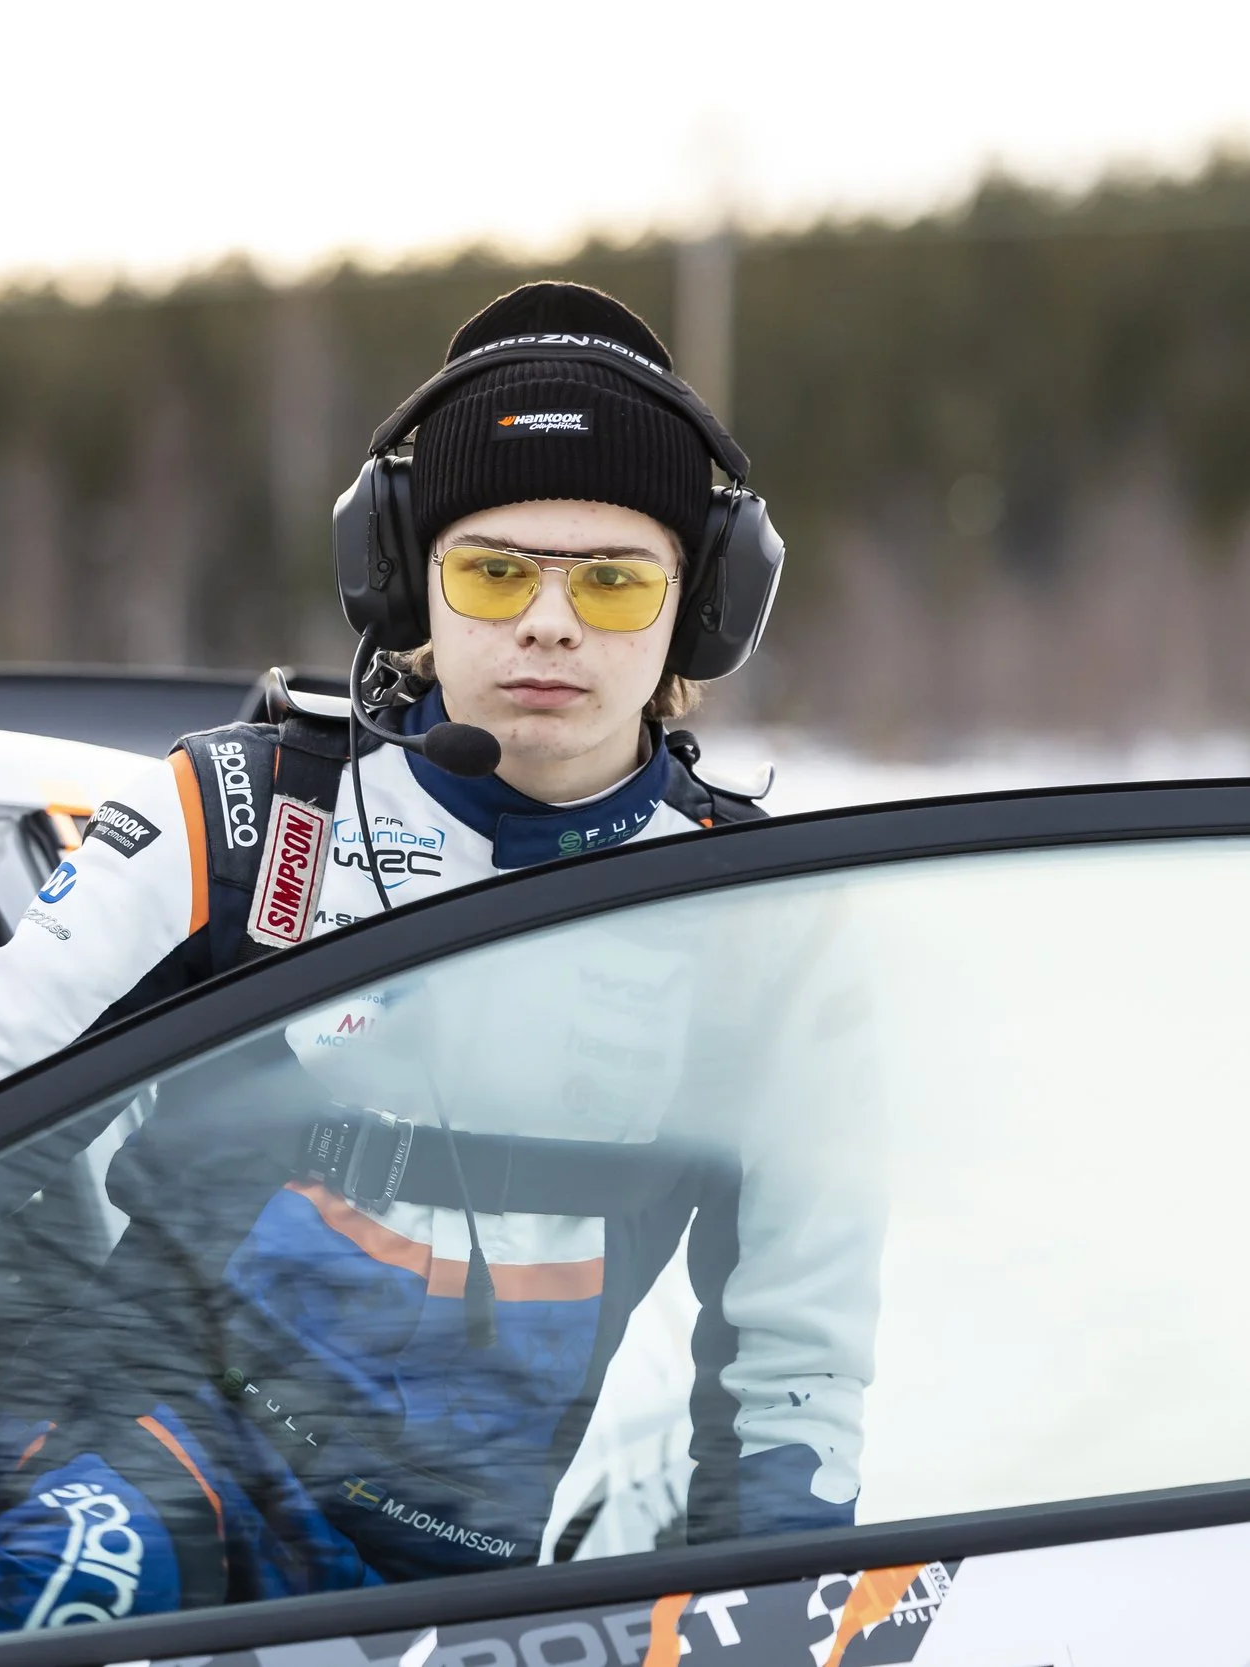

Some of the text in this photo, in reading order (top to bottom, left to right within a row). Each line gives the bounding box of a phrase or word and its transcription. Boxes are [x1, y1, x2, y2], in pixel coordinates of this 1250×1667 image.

[469, 333, 663, 375] ZERO ZN NOISE
[210, 741, 259, 849] sparco
[107, 828, 136, 851] emotion
[374, 816, 404, 828] FIA
[341, 831, 437, 850] JUNIOR
[267, 814, 315, 934] SIMPSON
[333, 846, 443, 877] WRC
[381, 1498, 517, 1558] M.JOHANSSON
